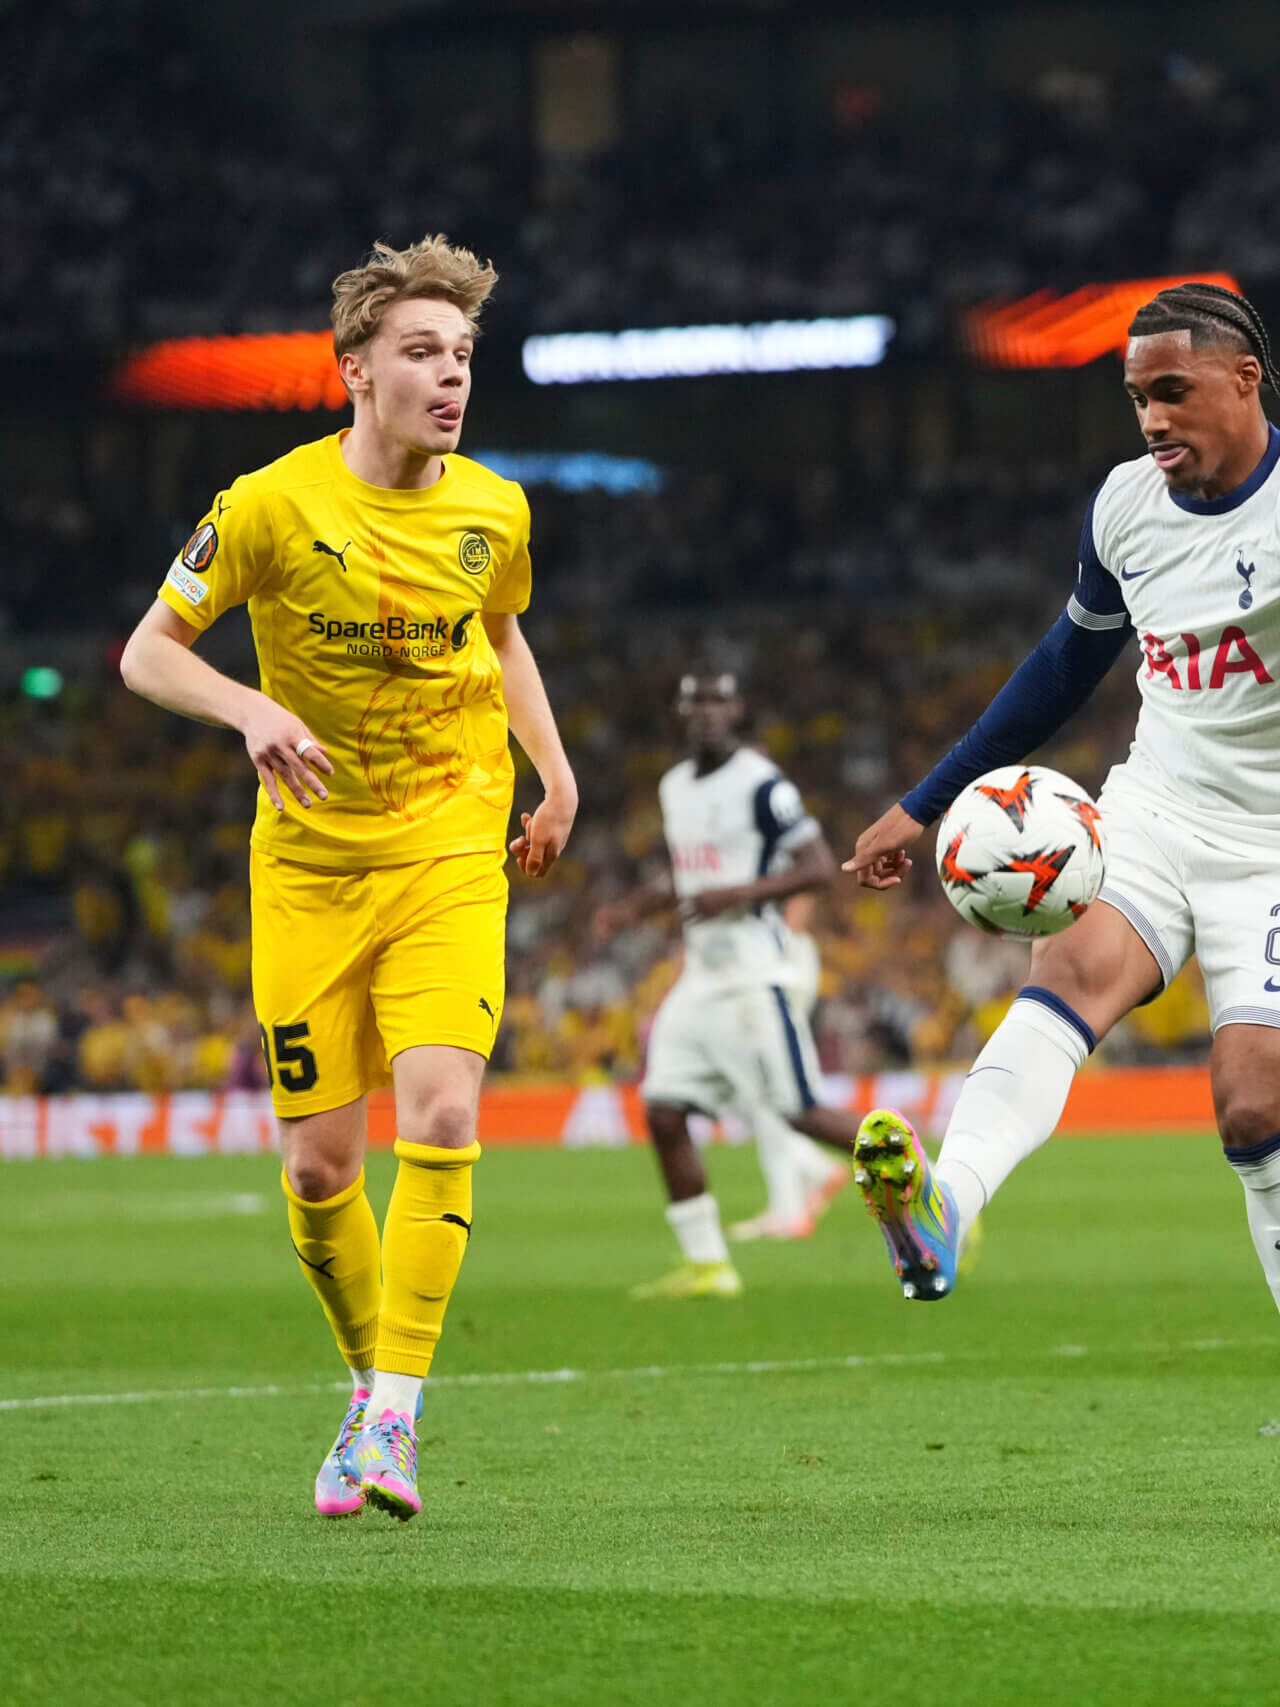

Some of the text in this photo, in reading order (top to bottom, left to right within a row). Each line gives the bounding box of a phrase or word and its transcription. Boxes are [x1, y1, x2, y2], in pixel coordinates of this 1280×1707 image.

[308, 612, 449, 640] SpareBank
[346, 643, 446, 658] NORD-NORGE
[1144, 625, 1275, 690] AIA
